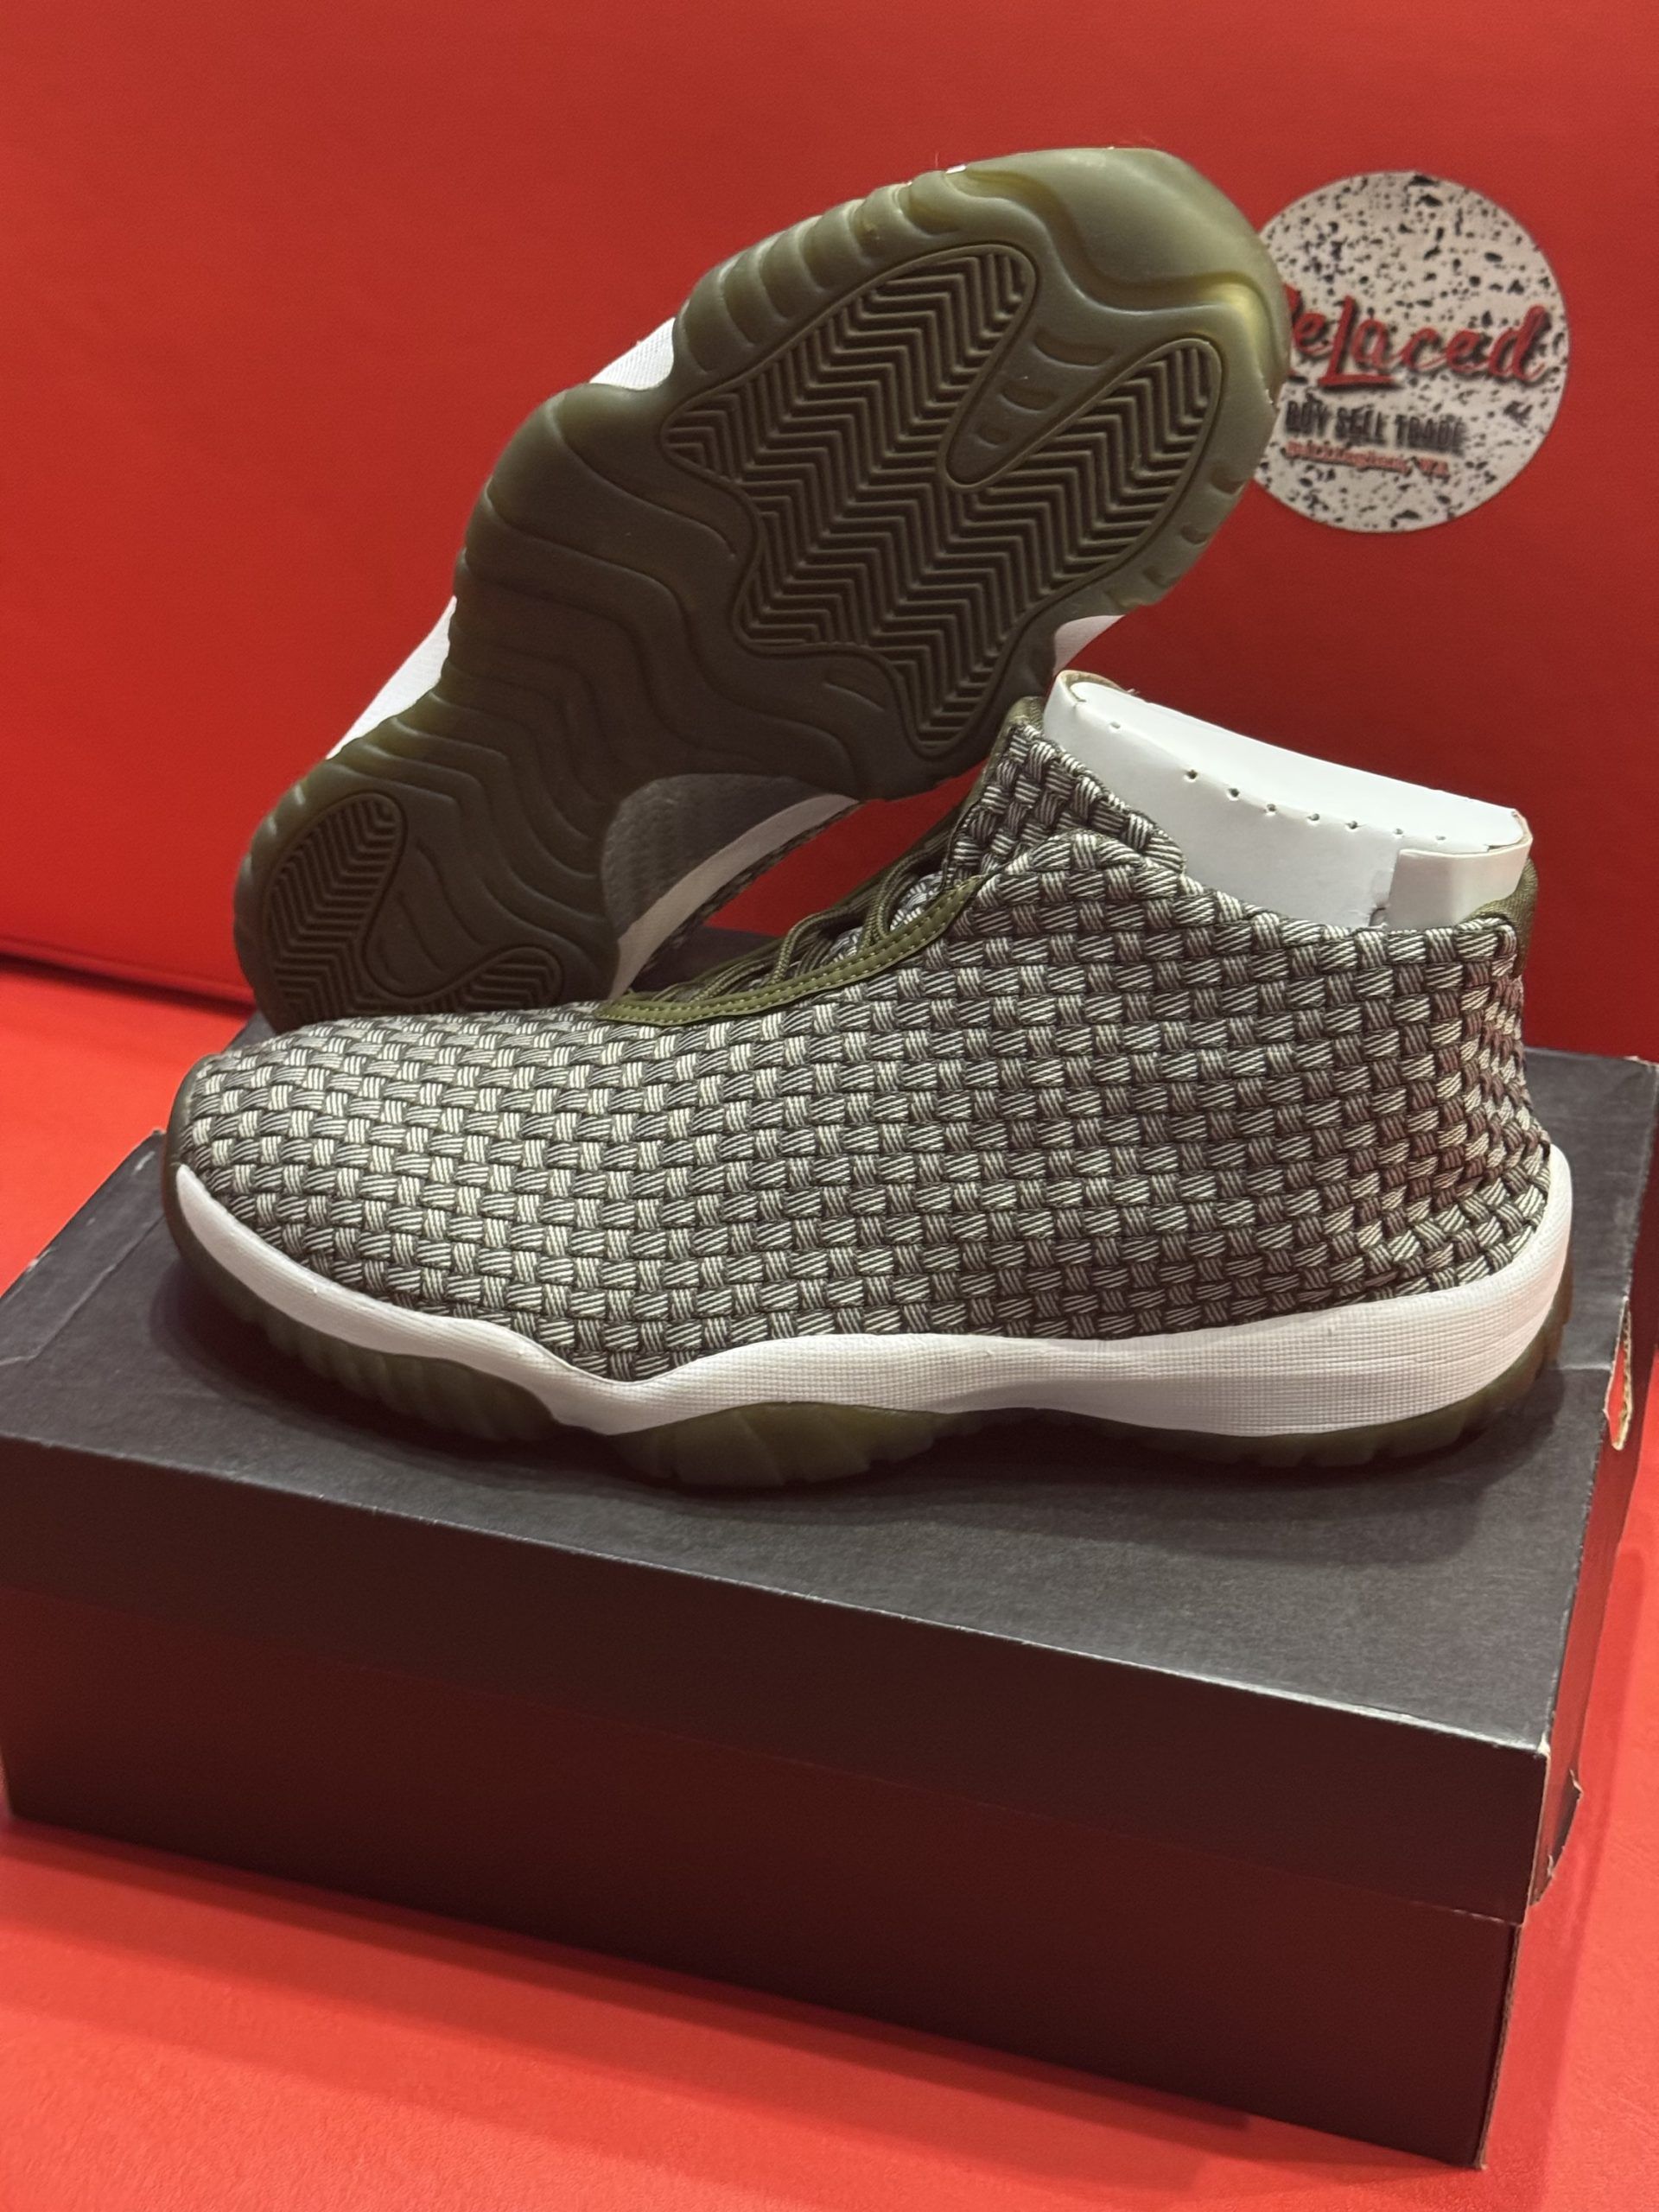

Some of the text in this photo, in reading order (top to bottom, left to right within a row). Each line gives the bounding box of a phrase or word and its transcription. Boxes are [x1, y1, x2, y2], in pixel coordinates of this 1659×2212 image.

[1283, 283, 1548, 385] eLaced
[1285, 400, 1467, 456] BUY SELL TRADE
